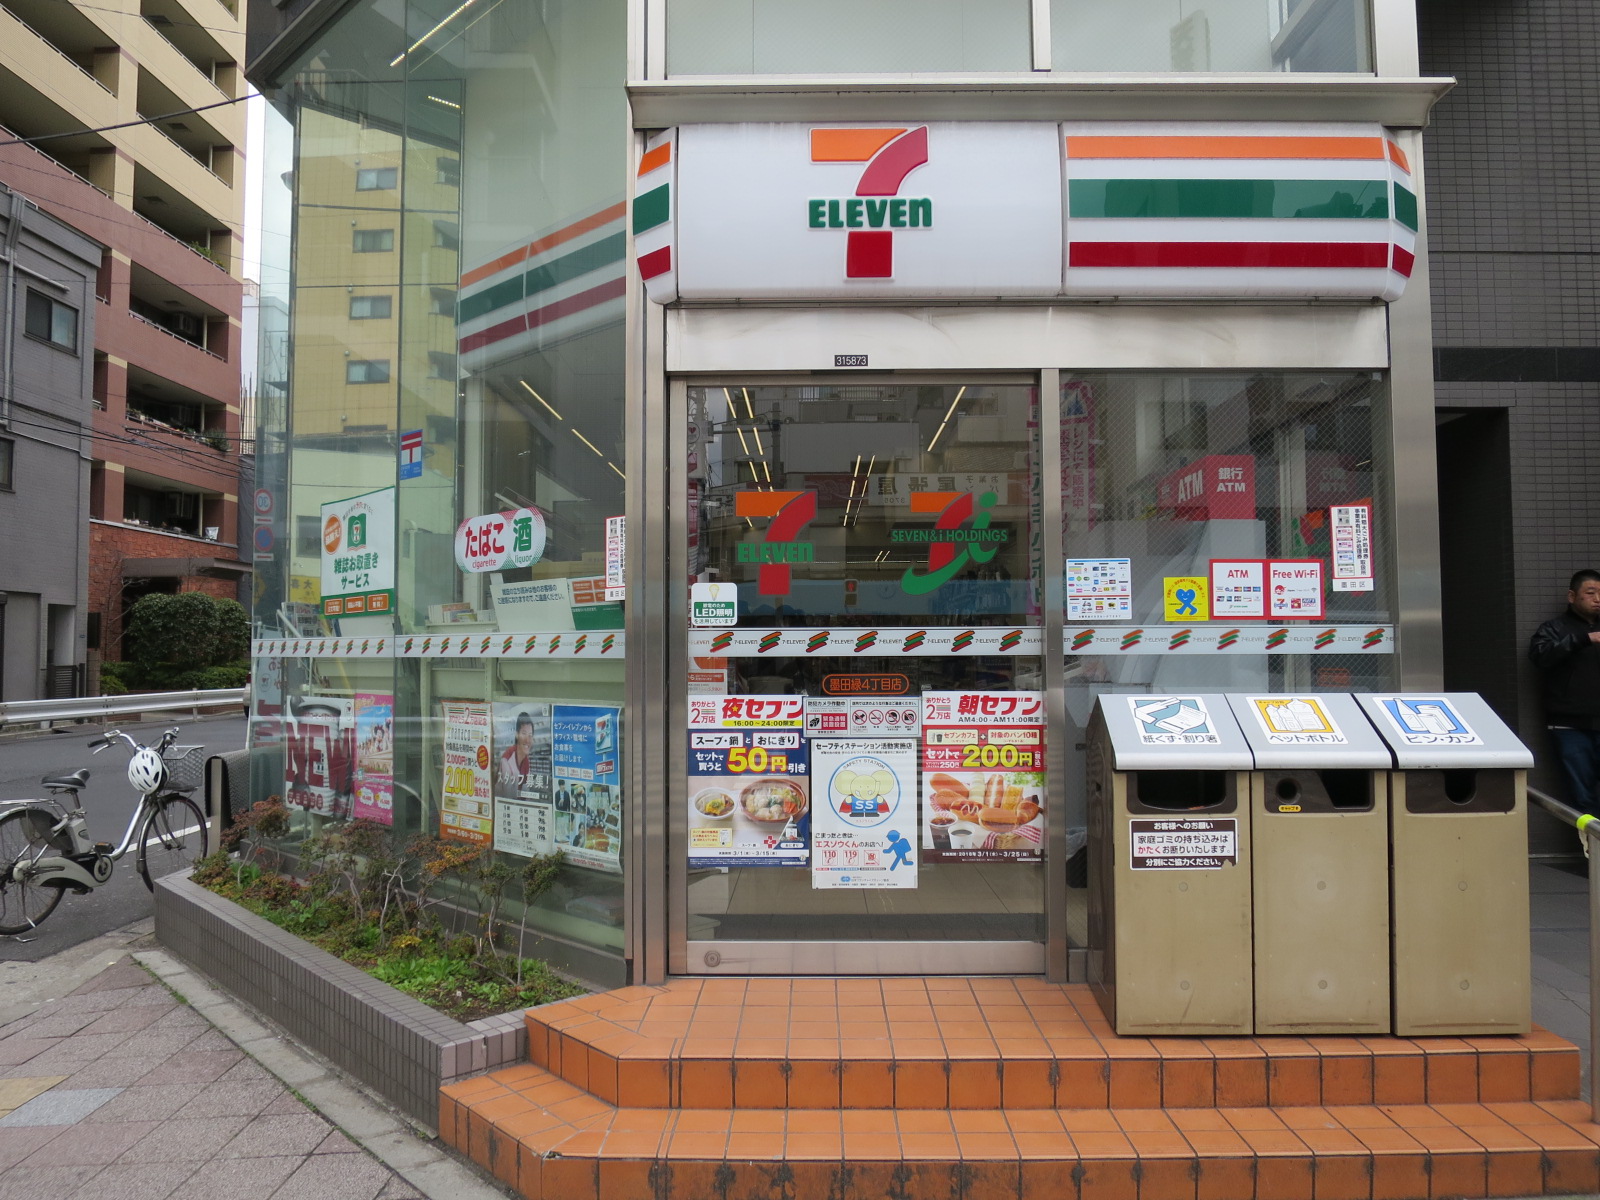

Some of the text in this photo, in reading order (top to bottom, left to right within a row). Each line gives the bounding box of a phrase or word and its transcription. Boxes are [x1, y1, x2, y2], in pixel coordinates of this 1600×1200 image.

[836, 355, 867, 366] 315873
[1218, 467, 1243, 480] 銀行
[1177, 470, 1203, 504] ATM
[1216, 482, 1246, 492] ATM
[465, 517, 532, 558] たばこ 酒
[946, 529, 1008, 542] HOLDINGS
[334, 552, 379, 574] 雑誌お取置き
[472, 554, 532, 569] cigarette liquor
[1227, 570, 1249, 578] ATM
[1272, 570, 1318, 578] Free Wi-Fi
[340, 573, 370, 590] サービス
[696, 608, 733, 617] LED照明
[830, 678, 902, 691] 墨田緑4丁目店
[722, 697, 804, 719] 夜セブン
[957, 694, 1041, 716] 朝セブン
[690, 708, 716, 724] 2万店
[926, 704, 951, 720] 2万店
[696, 736, 739, 746] スープ・鍋
[757, 736, 796, 746] おにぎり
[1142, 734, 1476, 744] 紙くず・割り箸 ペットボトル ビン・カン
[816, 742, 912, 750] セーフティステーション活動実施店
[695, 752, 724, 761] セットで
[926, 748, 960, 760] セットで
[962, 744, 1033, 768] 200円
[698, 762, 722, 771] 買うと
[842, 758, 885, 769] SAFETY STATION
[445, 765, 474, 797] 2,000
[498, 770, 549, 789] スタッフ募集!
[855, 800, 874, 810] SS
[1153, 822, 1214, 830] お客様へのお願い
[1137, 835, 1228, 844] 家庭ゴミの持ち込みは
[1138, 846, 1230, 854] かたくお断りいたします。
[1145, 858, 1222, 867] 分別にご協力ください。
